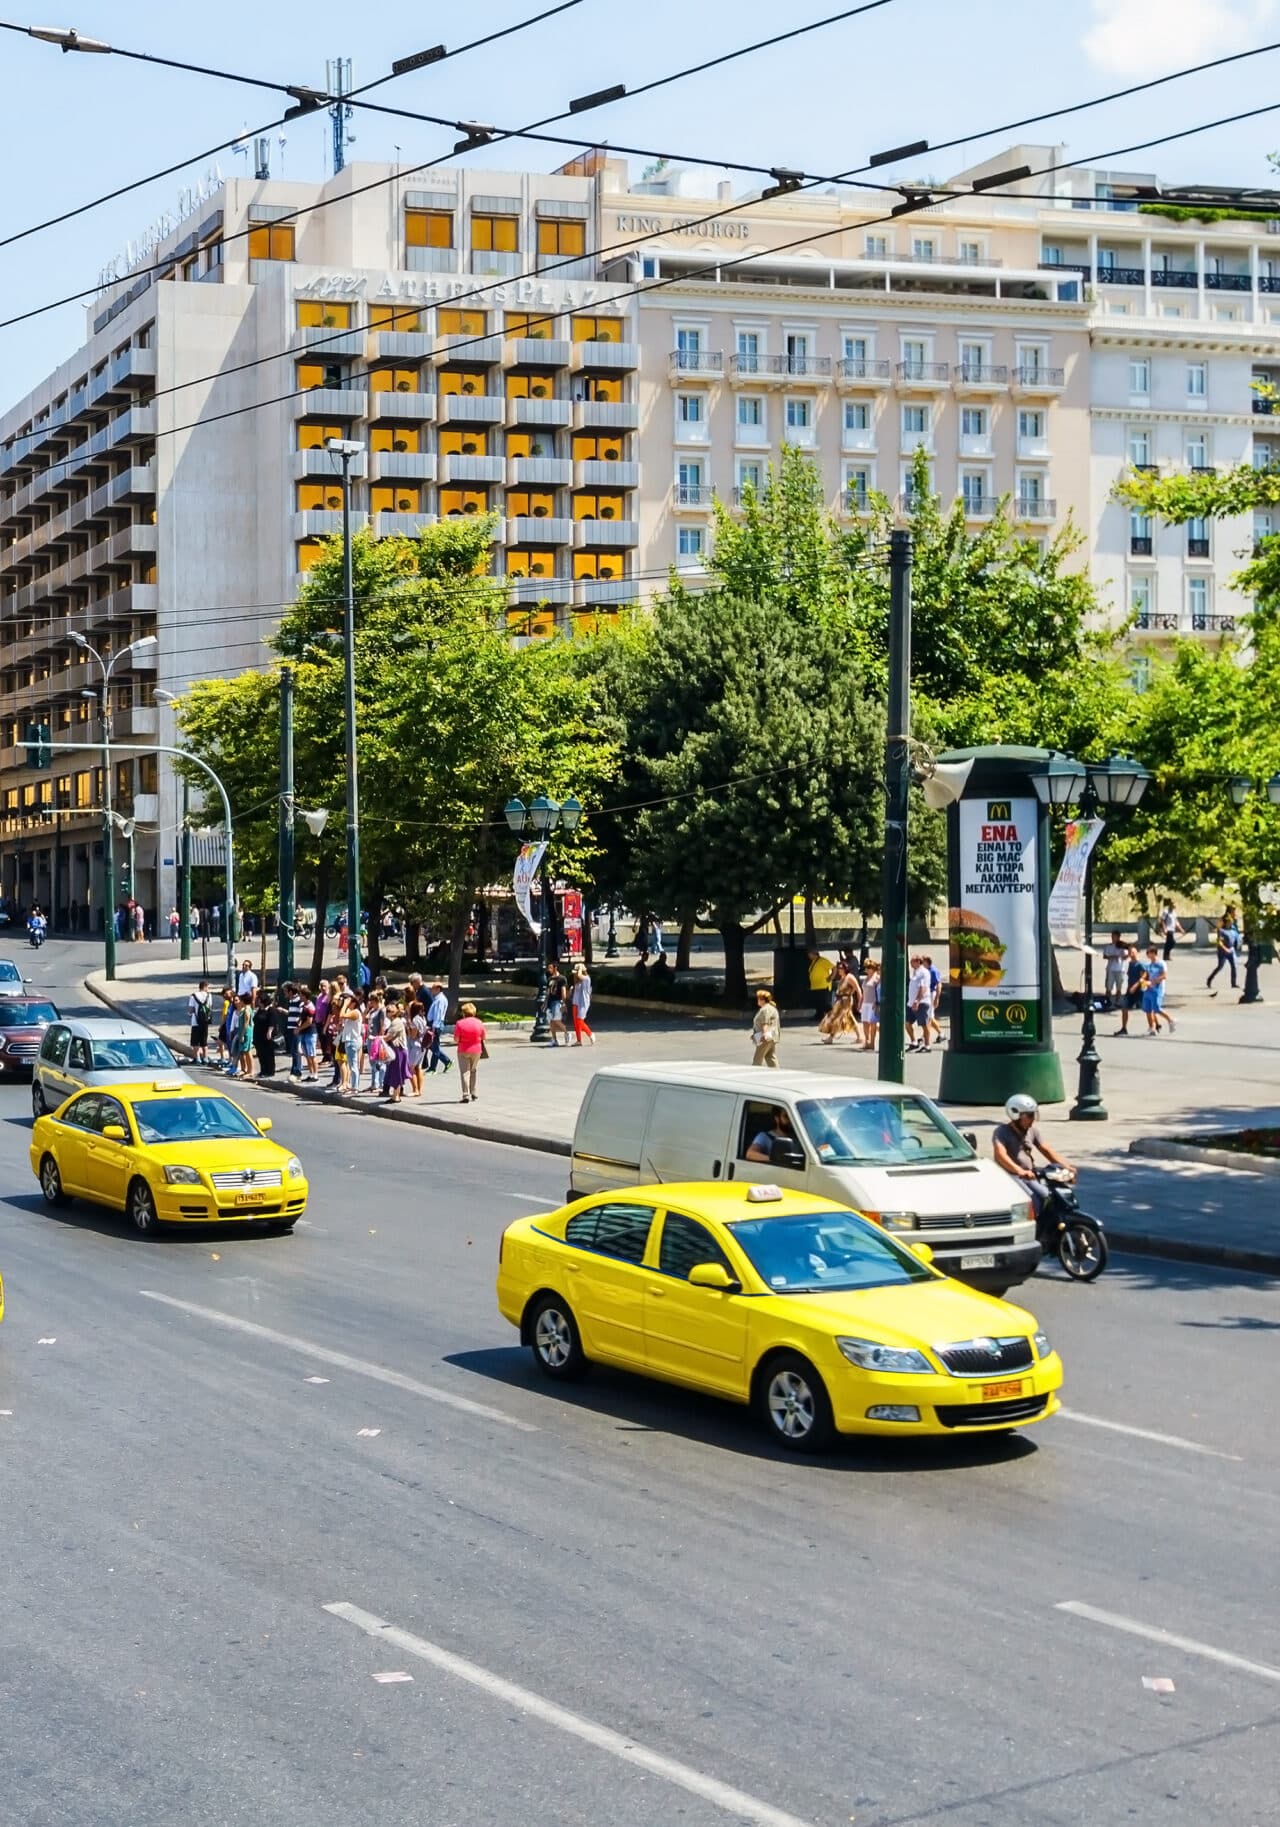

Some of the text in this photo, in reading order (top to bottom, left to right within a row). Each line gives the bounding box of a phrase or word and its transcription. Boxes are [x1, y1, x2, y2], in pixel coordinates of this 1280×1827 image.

[617, 216, 750, 239] KING GEORGE
[376, 277, 508, 303] ATHENS
[523, 280, 622, 308] PLAZA
[981, 825, 1018, 841] ΕΝΑ
[977, 842, 1023, 852] ΕΙΝΑΙ ΤΟ
[977, 852, 994, 862] BIG
[975, 863, 1024, 873] ΚΑΙ ΤΩΡΑ
[980, 873, 1020, 883] ΑΚΟΜΑ
